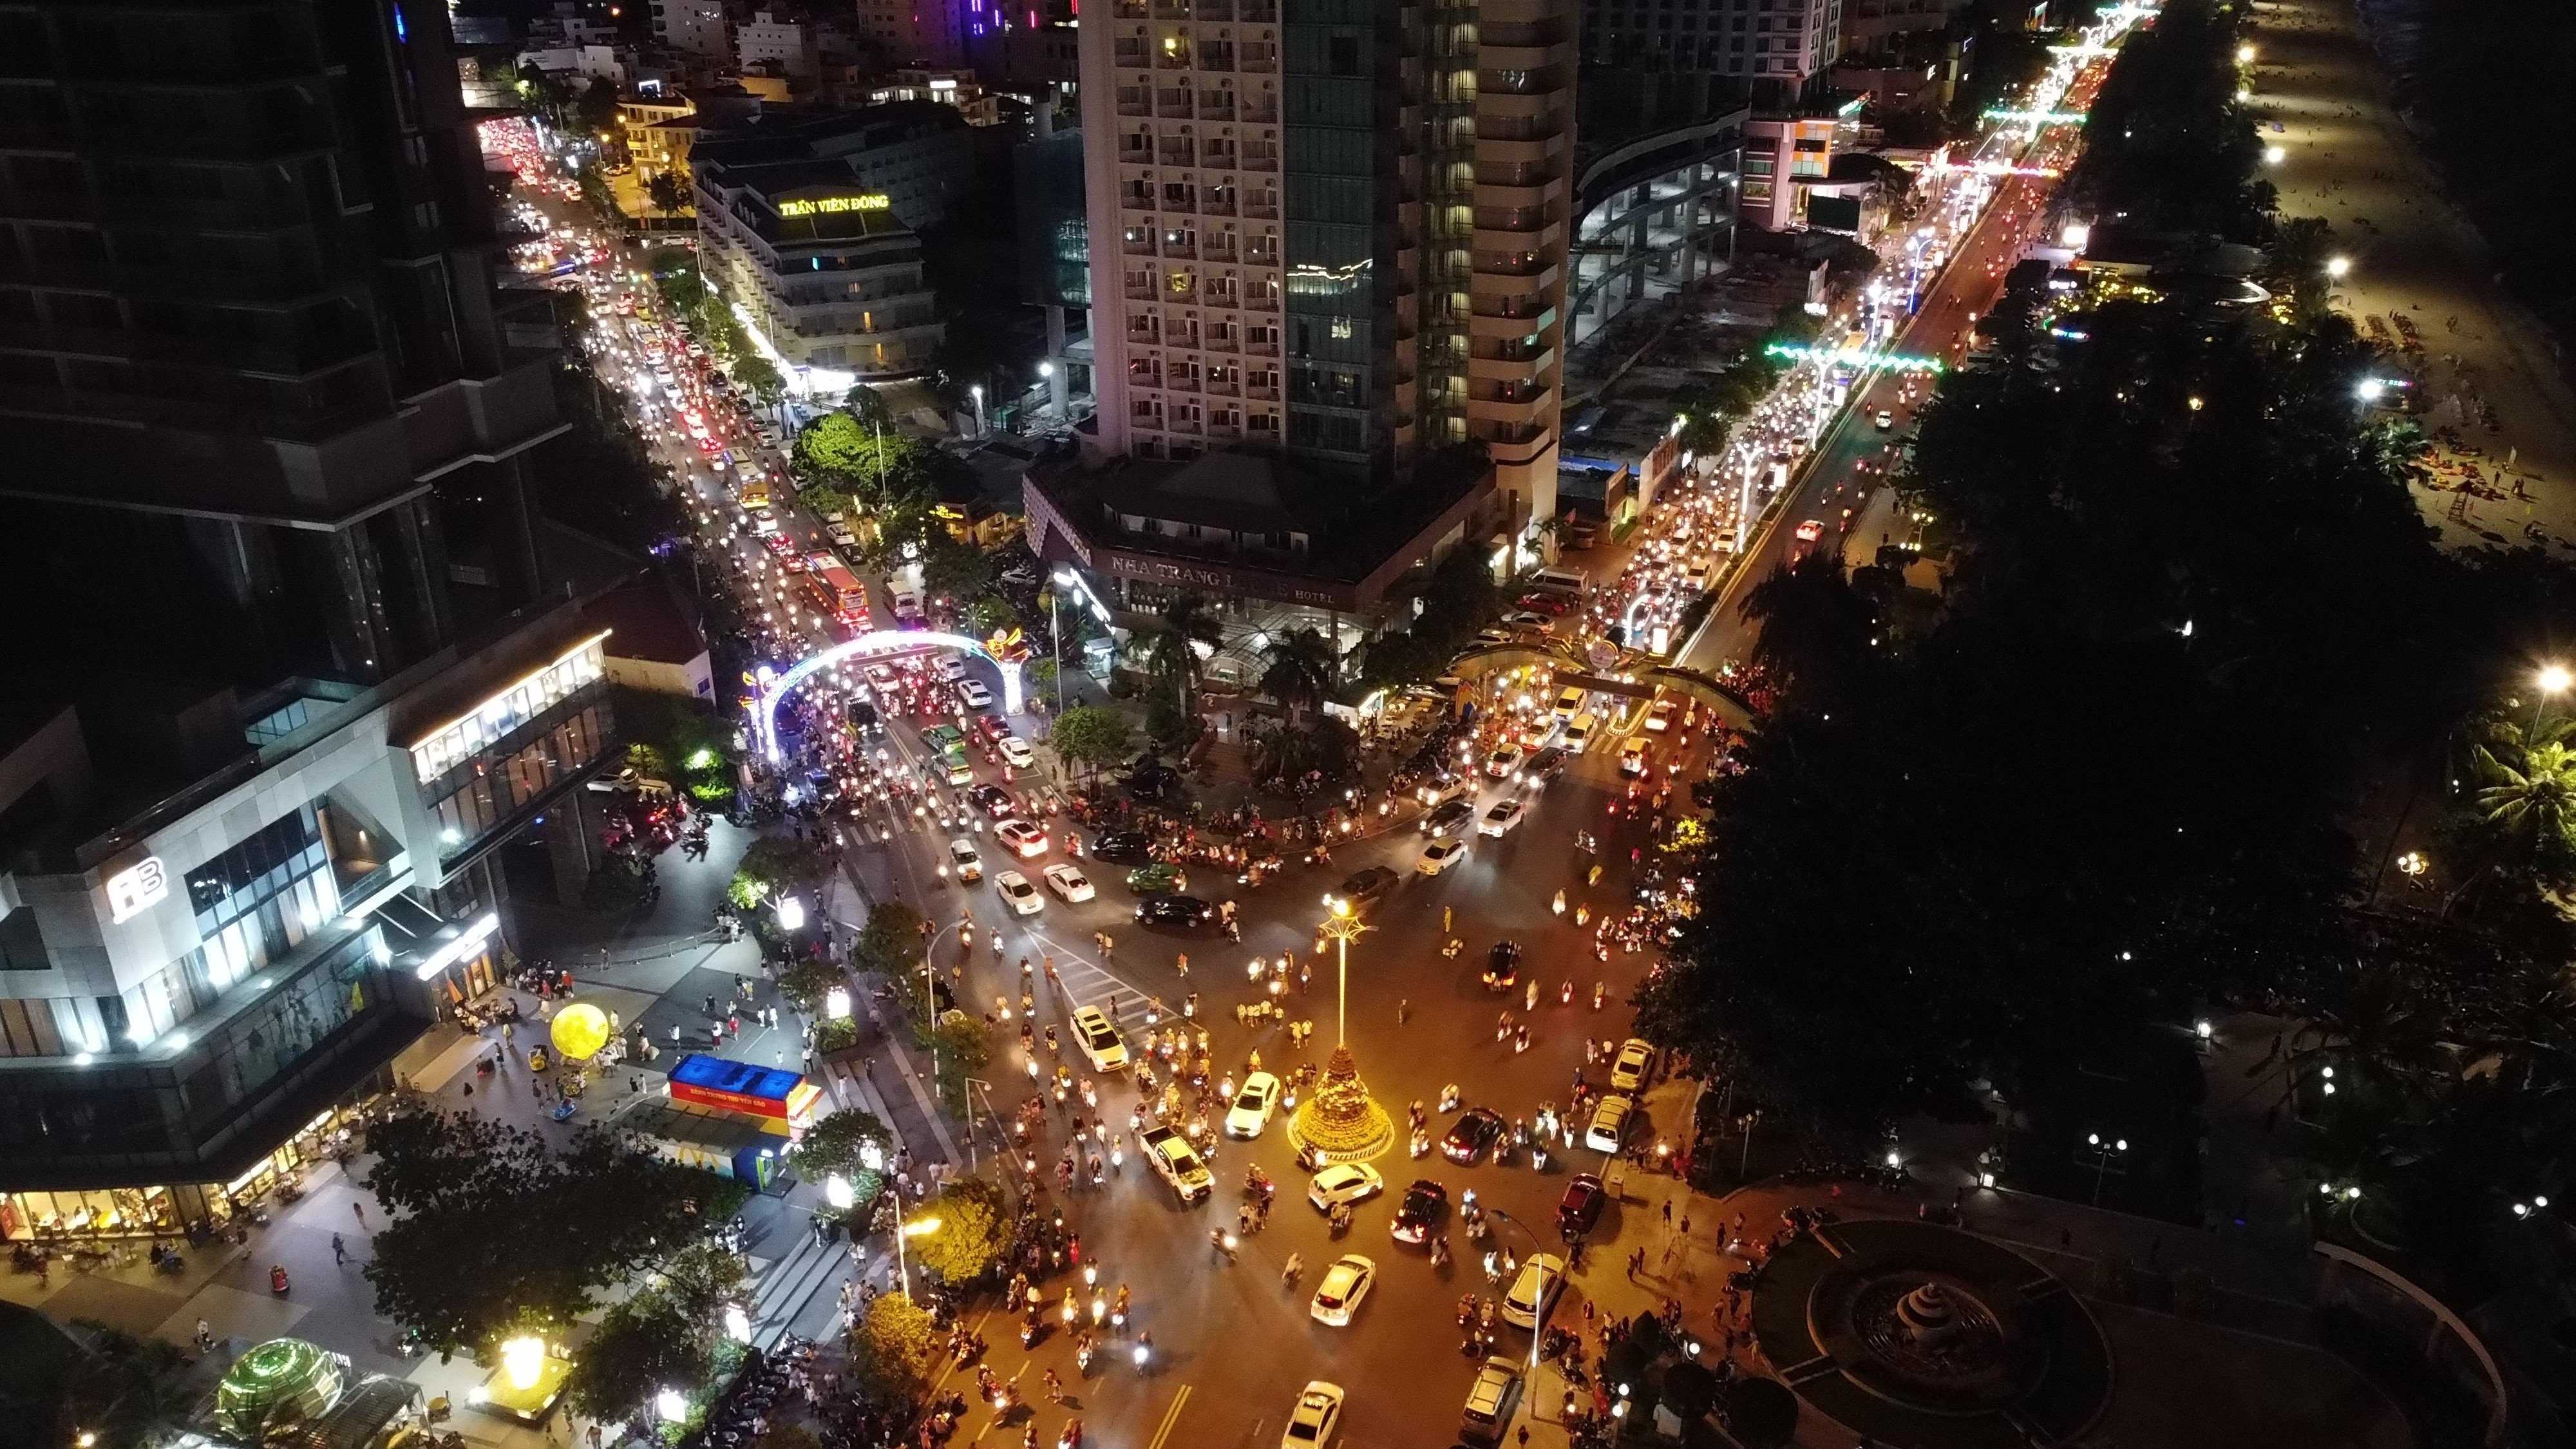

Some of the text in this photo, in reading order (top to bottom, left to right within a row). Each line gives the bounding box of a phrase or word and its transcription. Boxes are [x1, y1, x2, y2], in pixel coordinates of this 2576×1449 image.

[1112, 556, 1151, 575] NHA
[1156, 563, 1220, 586] TRANG
[1295, 589, 1335, 604] HOTEL
